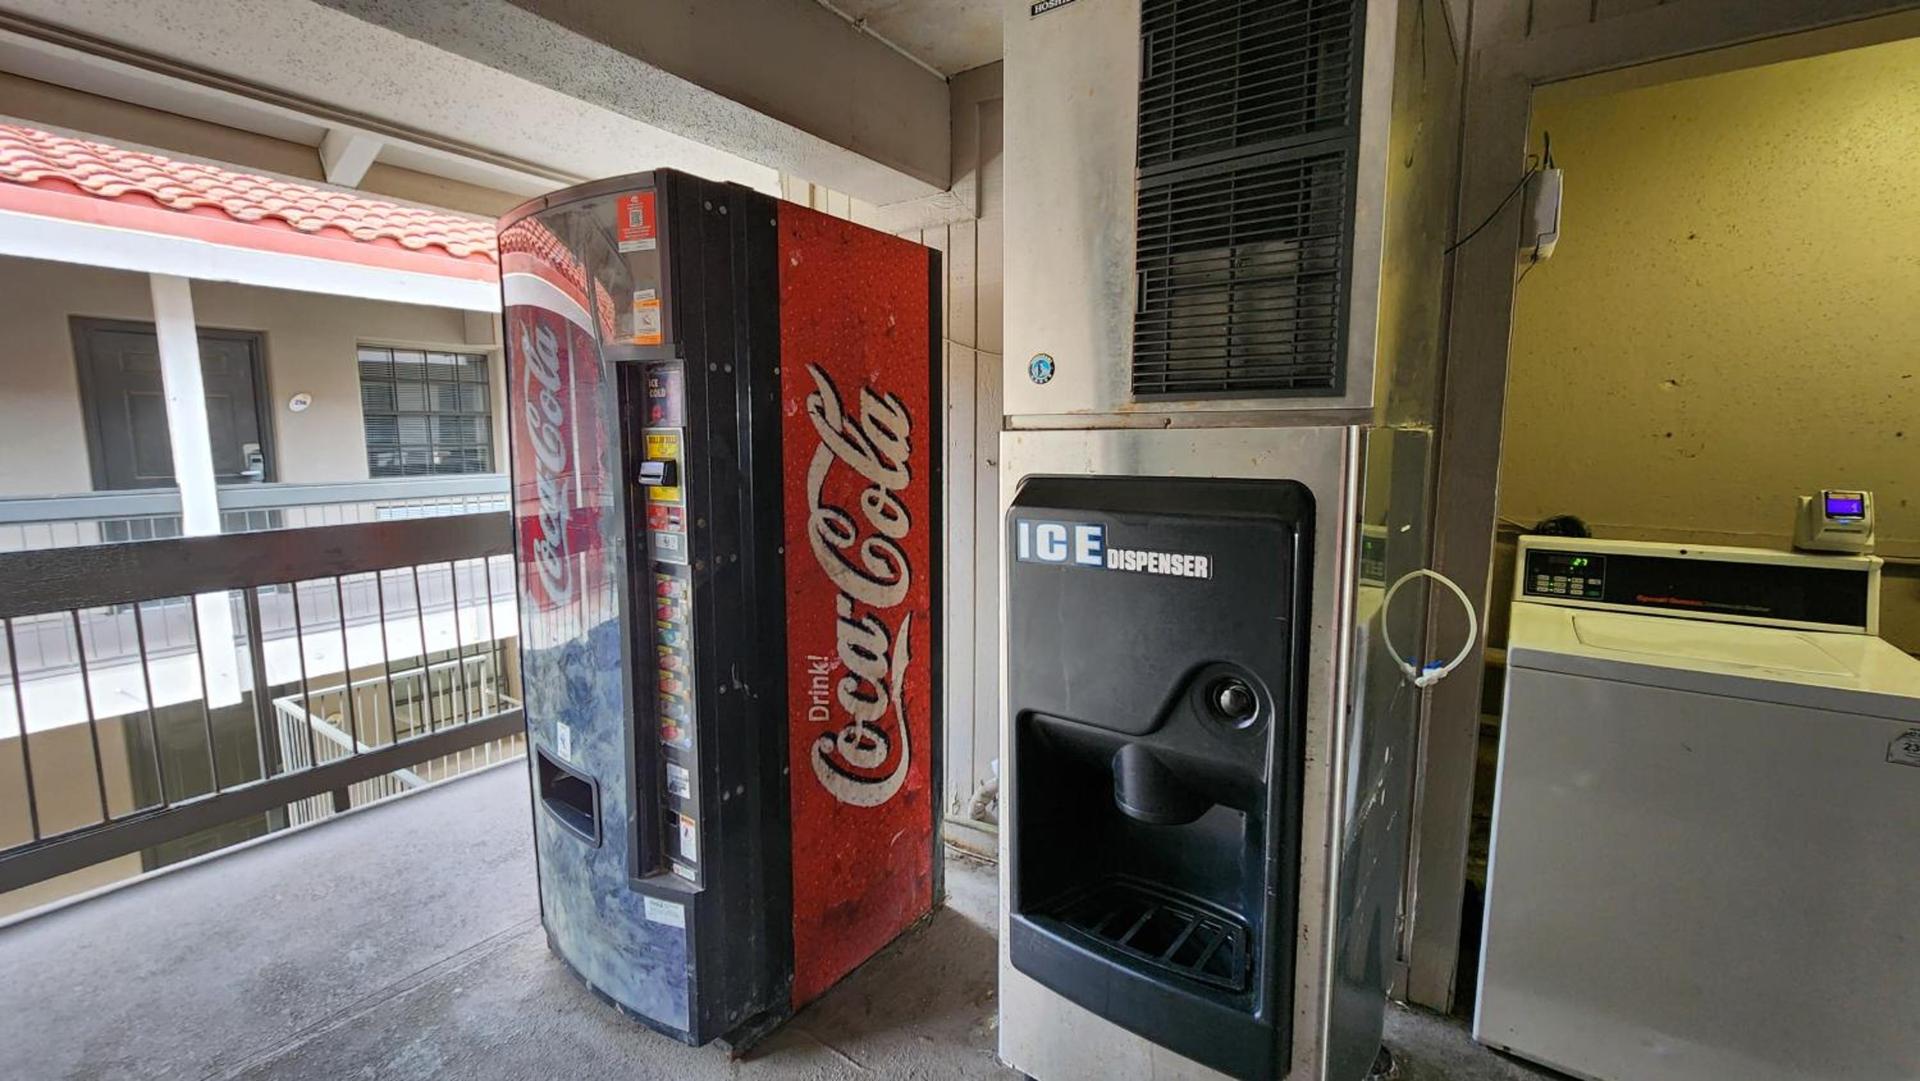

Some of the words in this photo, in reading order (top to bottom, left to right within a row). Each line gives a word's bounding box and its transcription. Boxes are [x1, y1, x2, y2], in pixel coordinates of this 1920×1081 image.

[648, 378, 659, 388] ICE
[649, 387, 666, 398] COLD
[1019, 522, 1103, 566] ICE
[1106, 548, 1208, 579] DISPENSER
[805, 362, 912, 808] Coca-Cola
[808, 655, 829, 722] Drink!
